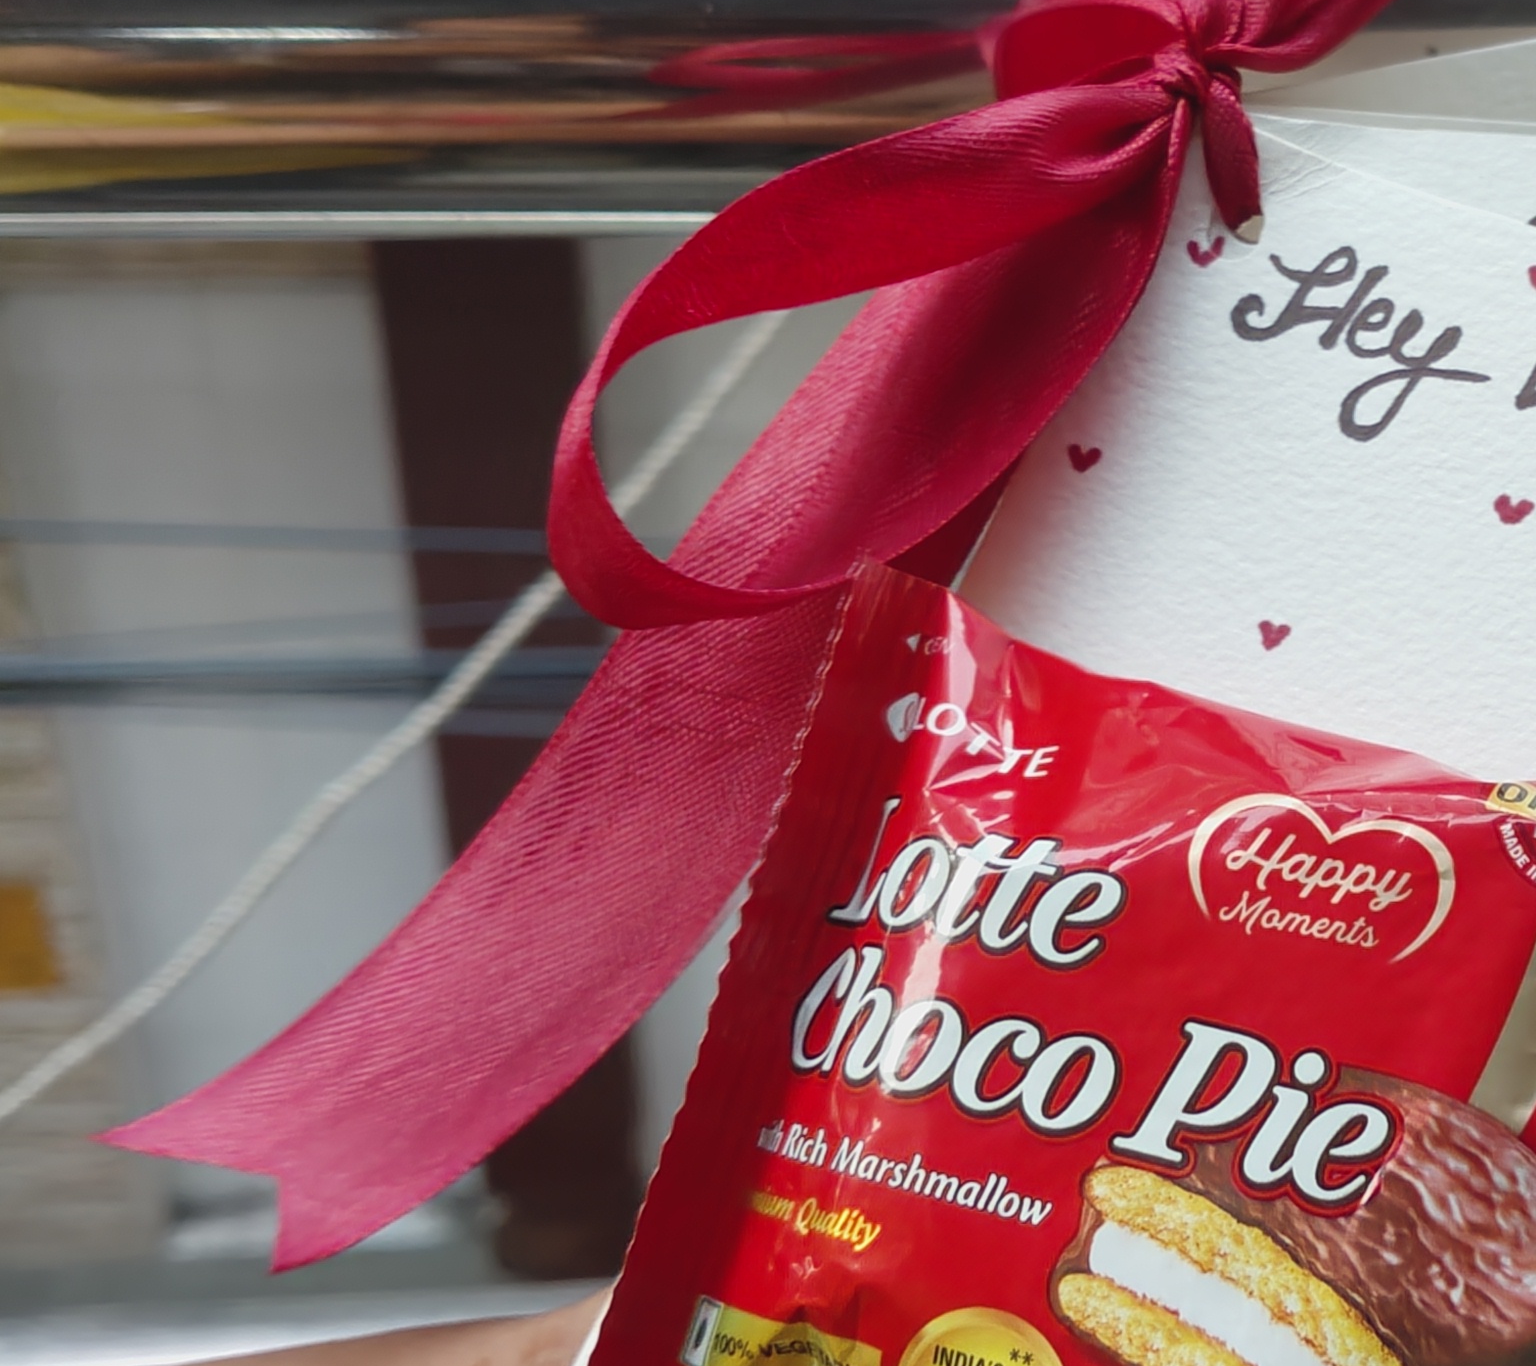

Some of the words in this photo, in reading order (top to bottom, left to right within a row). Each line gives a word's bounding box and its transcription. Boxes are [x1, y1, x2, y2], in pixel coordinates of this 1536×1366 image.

[1231, 246, 1492, 442] Hey
[911, 696, 1061, 778] LOTTE
[828, 794, 1127, 971] Lotte
[1225, 827, 1413, 912] Happy
[1500, 822, 1525, 869] MADE
[1219, 890, 1380, 948] Moments
[789, 942, 1122, 1136] Choco
[1106, 1017, 1395, 1206] Pie
[781, 1122, 829, 1168] Rich
[830, 1136, 1053, 1226] Marshmallow
[795, 1197, 882, 1252] Quality
[713, 1333, 755, 1361] 100%
